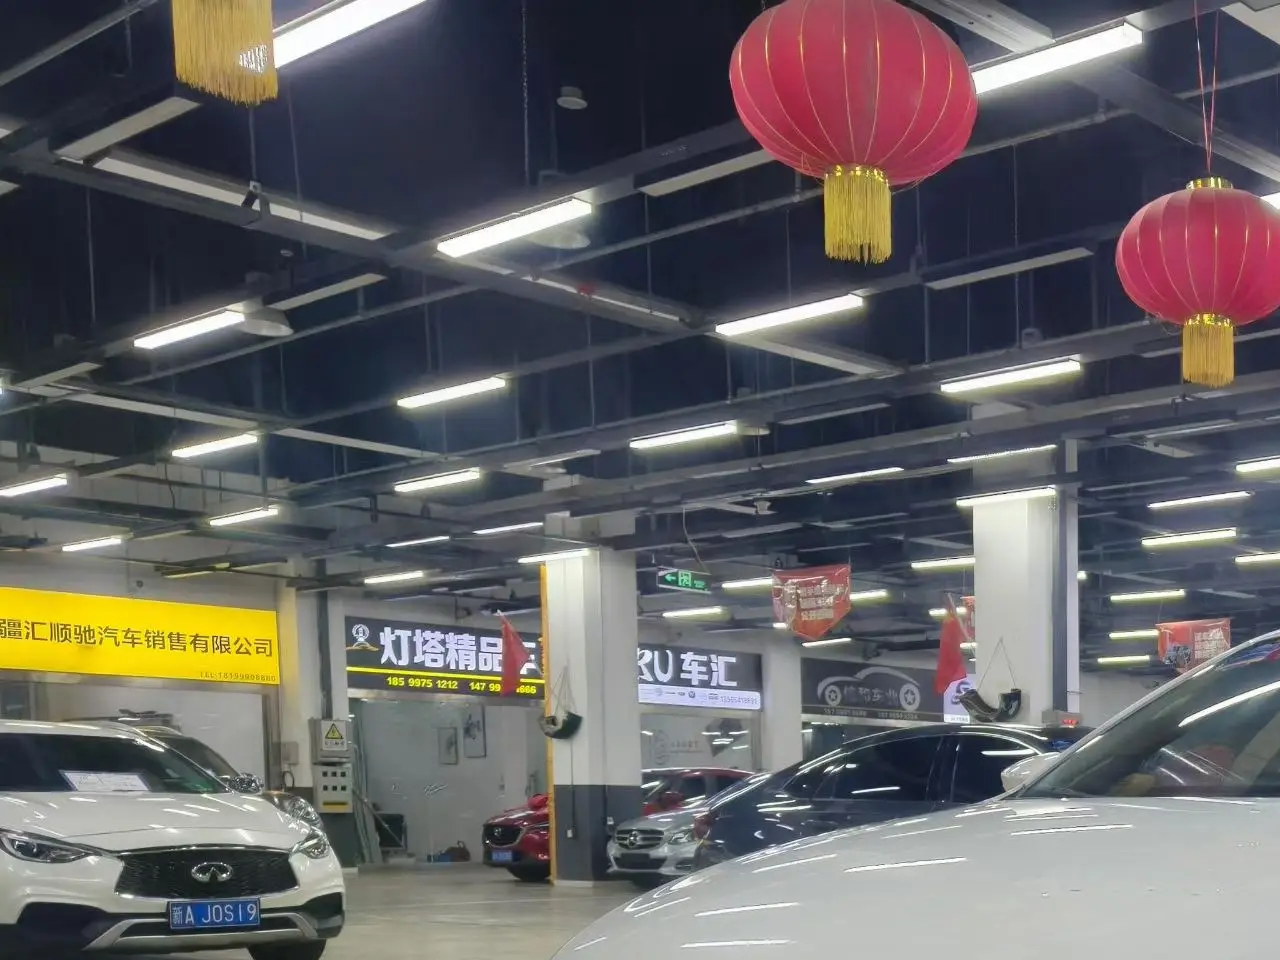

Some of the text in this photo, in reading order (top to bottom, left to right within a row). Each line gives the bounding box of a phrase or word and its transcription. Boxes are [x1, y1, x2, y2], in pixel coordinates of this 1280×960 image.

[680, 651, 738, 687] 车汇
[387, 676, 404, 687] 185
[408, 678, 433, 689] 9975
[436, 681, 458, 690] 1212
[469, 682, 485, 692] 147
